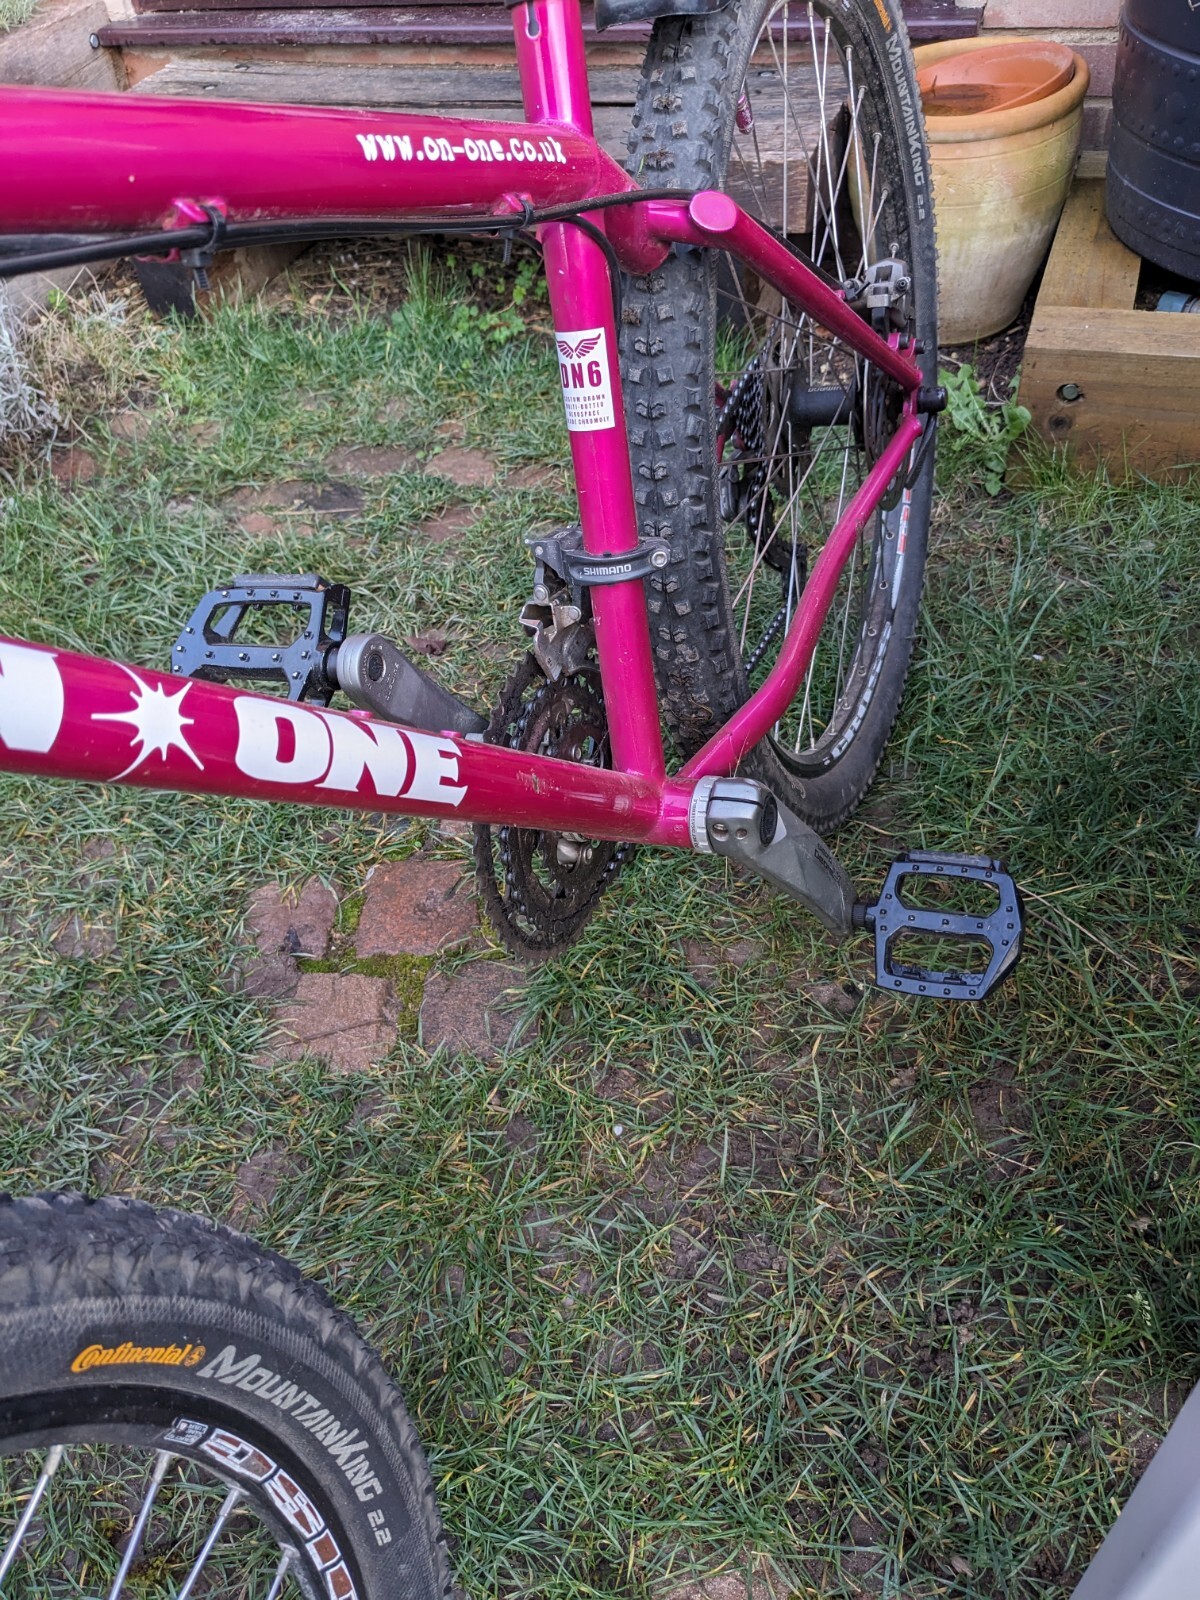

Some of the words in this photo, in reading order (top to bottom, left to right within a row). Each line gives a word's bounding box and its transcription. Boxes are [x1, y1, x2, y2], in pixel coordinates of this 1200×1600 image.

[583, 563, 632, 576] SHIMANO
[233, 696, 468, 807] ONE
[71, 1342, 192, 1373] Continental
[367, 1509, 392, 1547] 2.2
